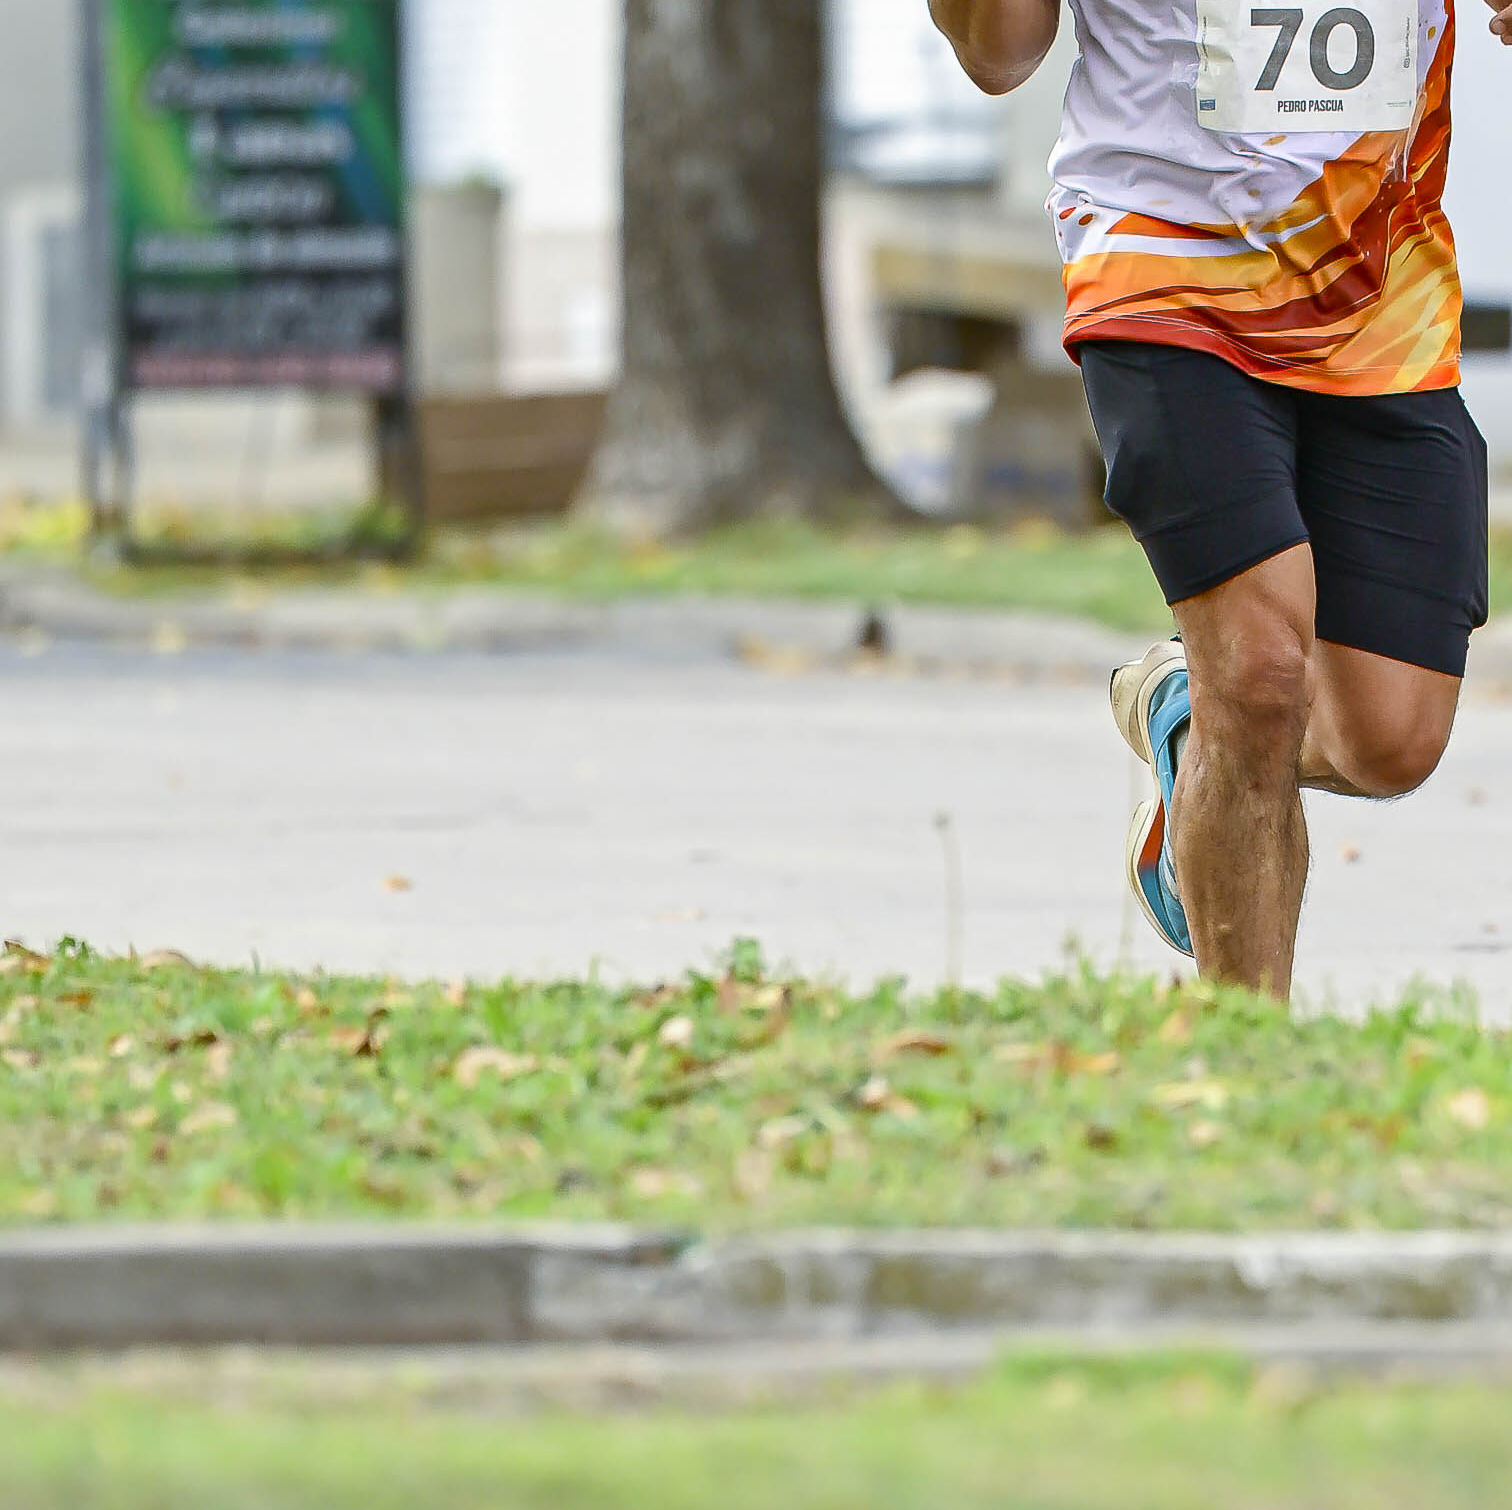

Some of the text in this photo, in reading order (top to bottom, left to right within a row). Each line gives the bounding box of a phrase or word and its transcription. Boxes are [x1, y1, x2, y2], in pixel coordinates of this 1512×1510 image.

[1250, 7, 1375, 91] 70
[1277, 99, 1344, 113] PEDRO PASCUA
